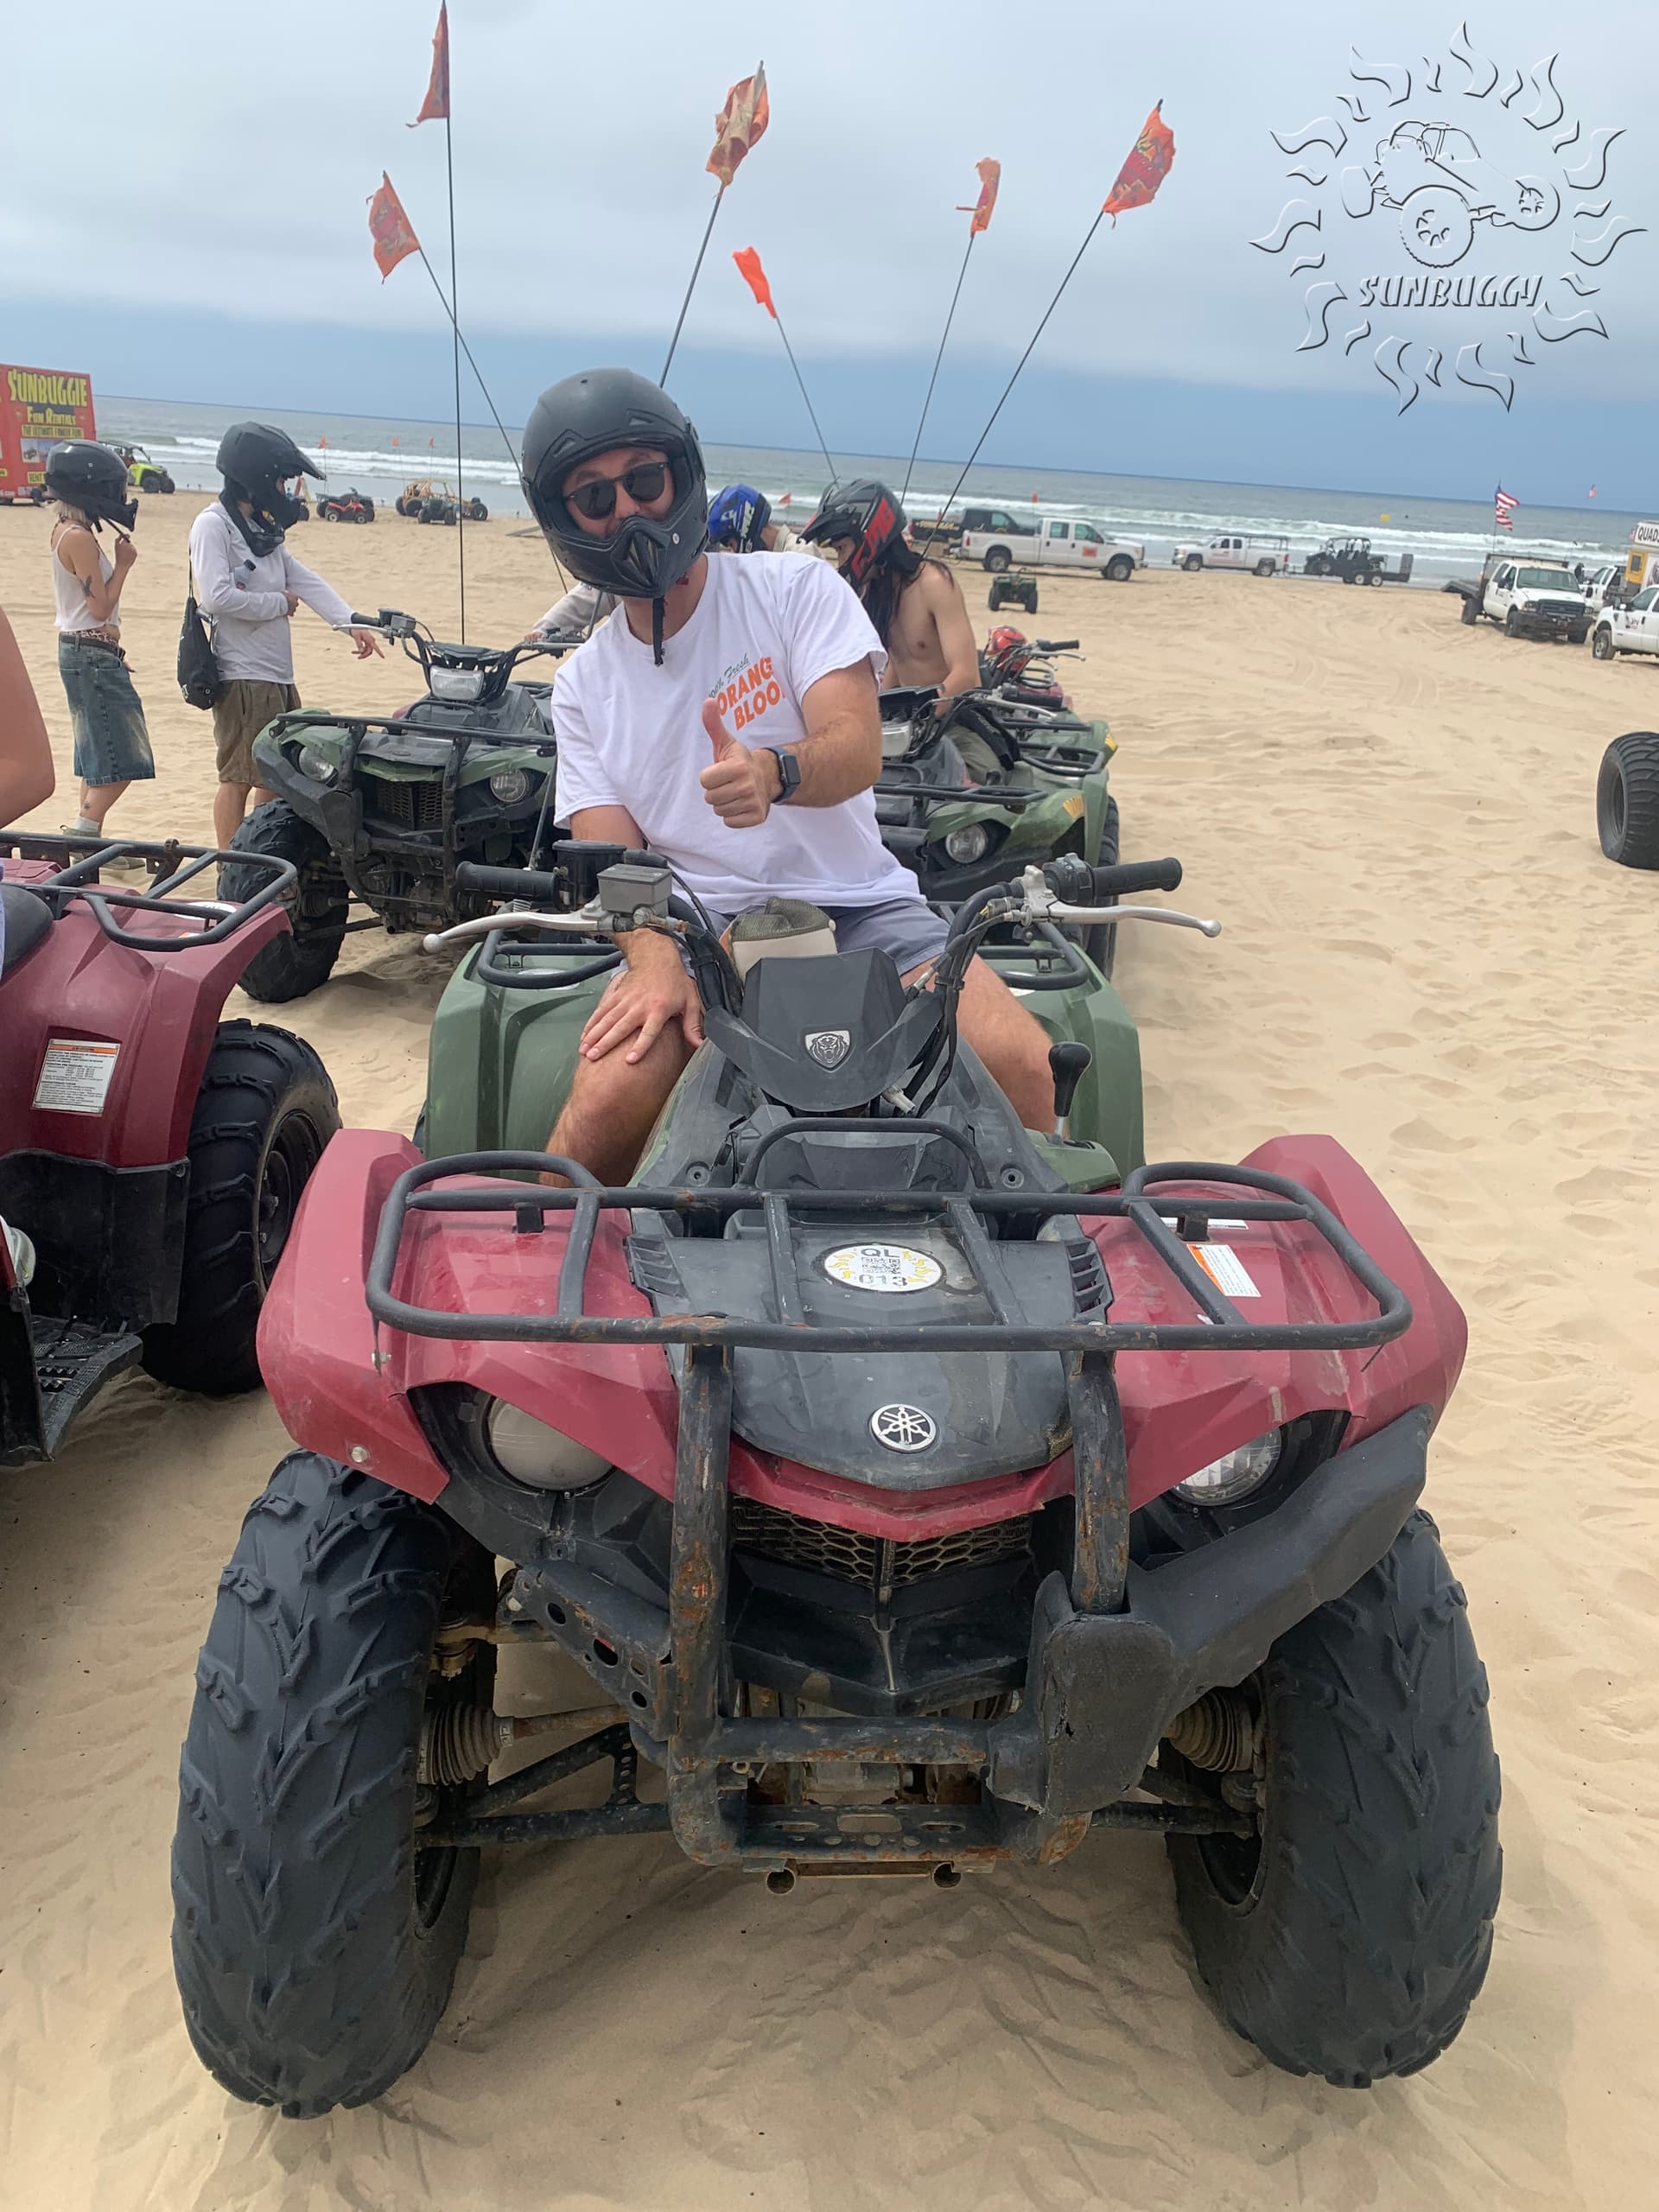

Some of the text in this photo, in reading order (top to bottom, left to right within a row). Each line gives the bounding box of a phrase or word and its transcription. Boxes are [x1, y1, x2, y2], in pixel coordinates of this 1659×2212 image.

[8, 369, 87, 407] SUNBUGGIE
[717, 657, 774, 715] ORANG
[734, 681, 785, 731] BLOO
